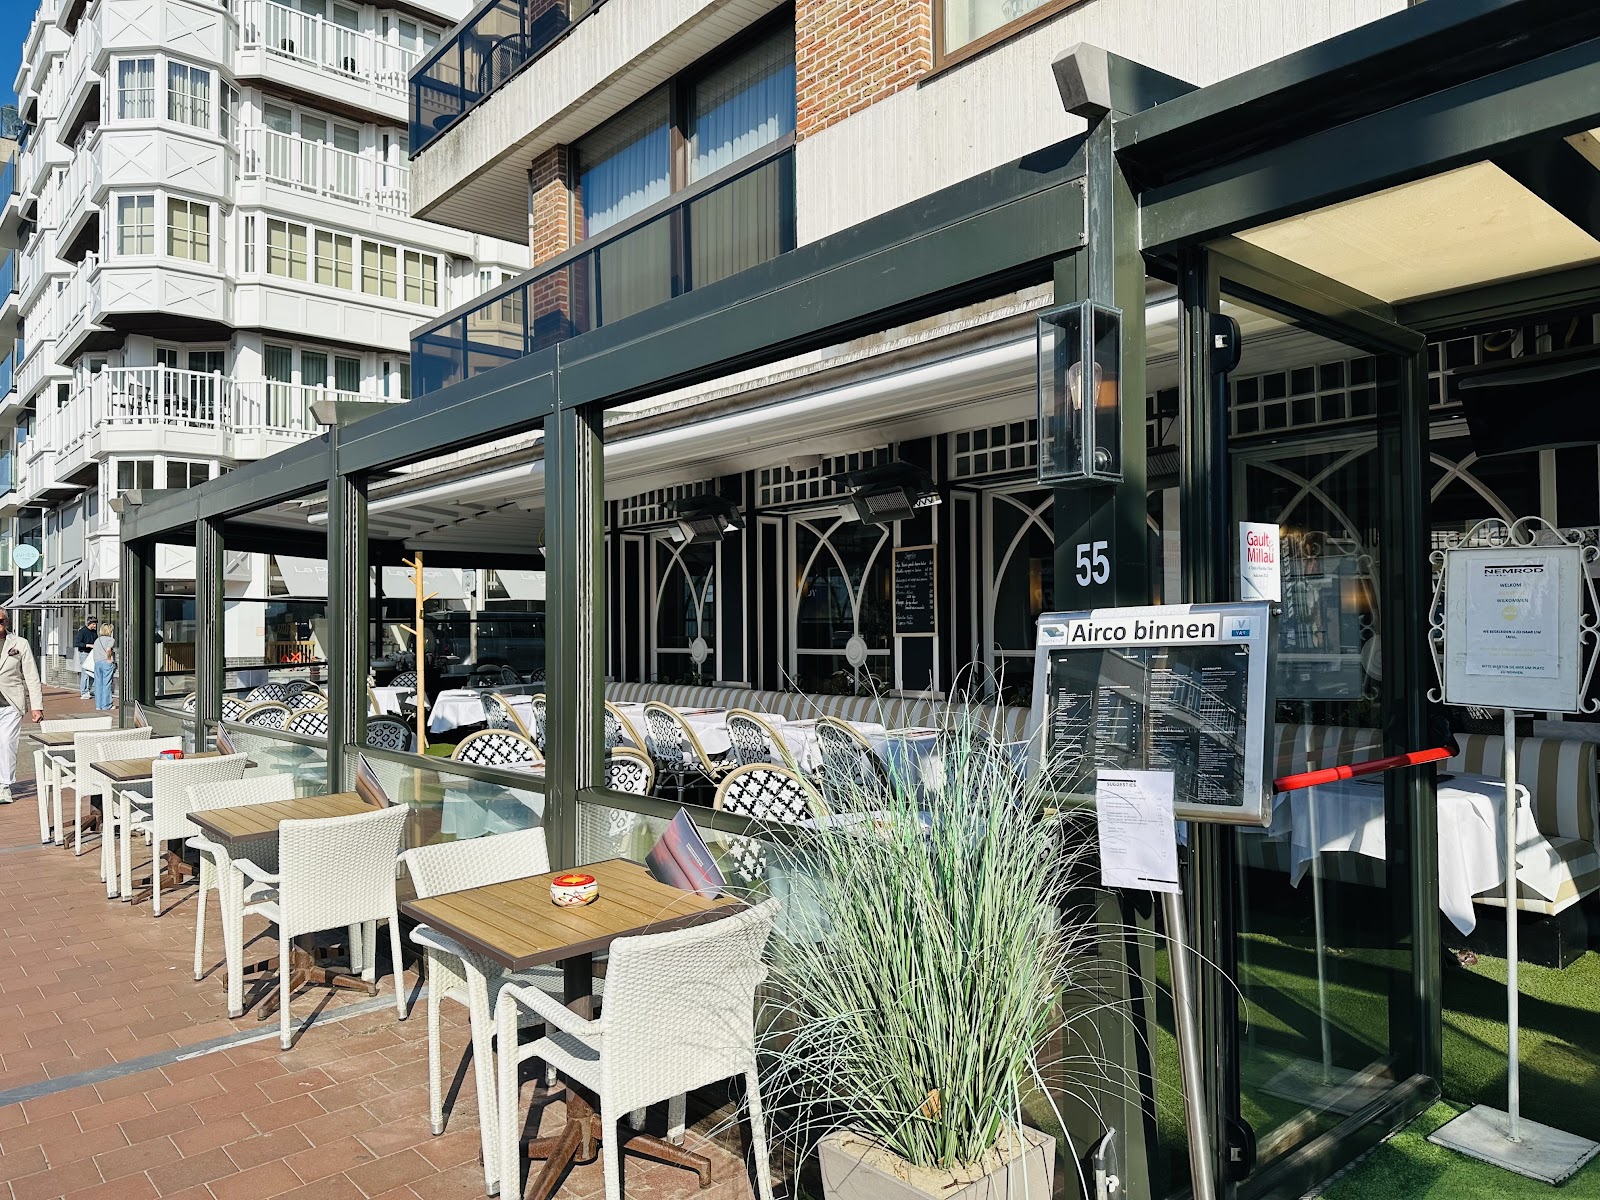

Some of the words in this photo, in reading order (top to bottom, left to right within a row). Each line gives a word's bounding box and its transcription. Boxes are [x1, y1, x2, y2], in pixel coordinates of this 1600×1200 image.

[1247, 531, 1269, 546] Gault
[1076, 541, 1110, 587] 55
[1248, 548, 1274, 563] Millau
[1071, 623, 1126, 642] Airco
[1134, 620, 1215, 640] binnen
